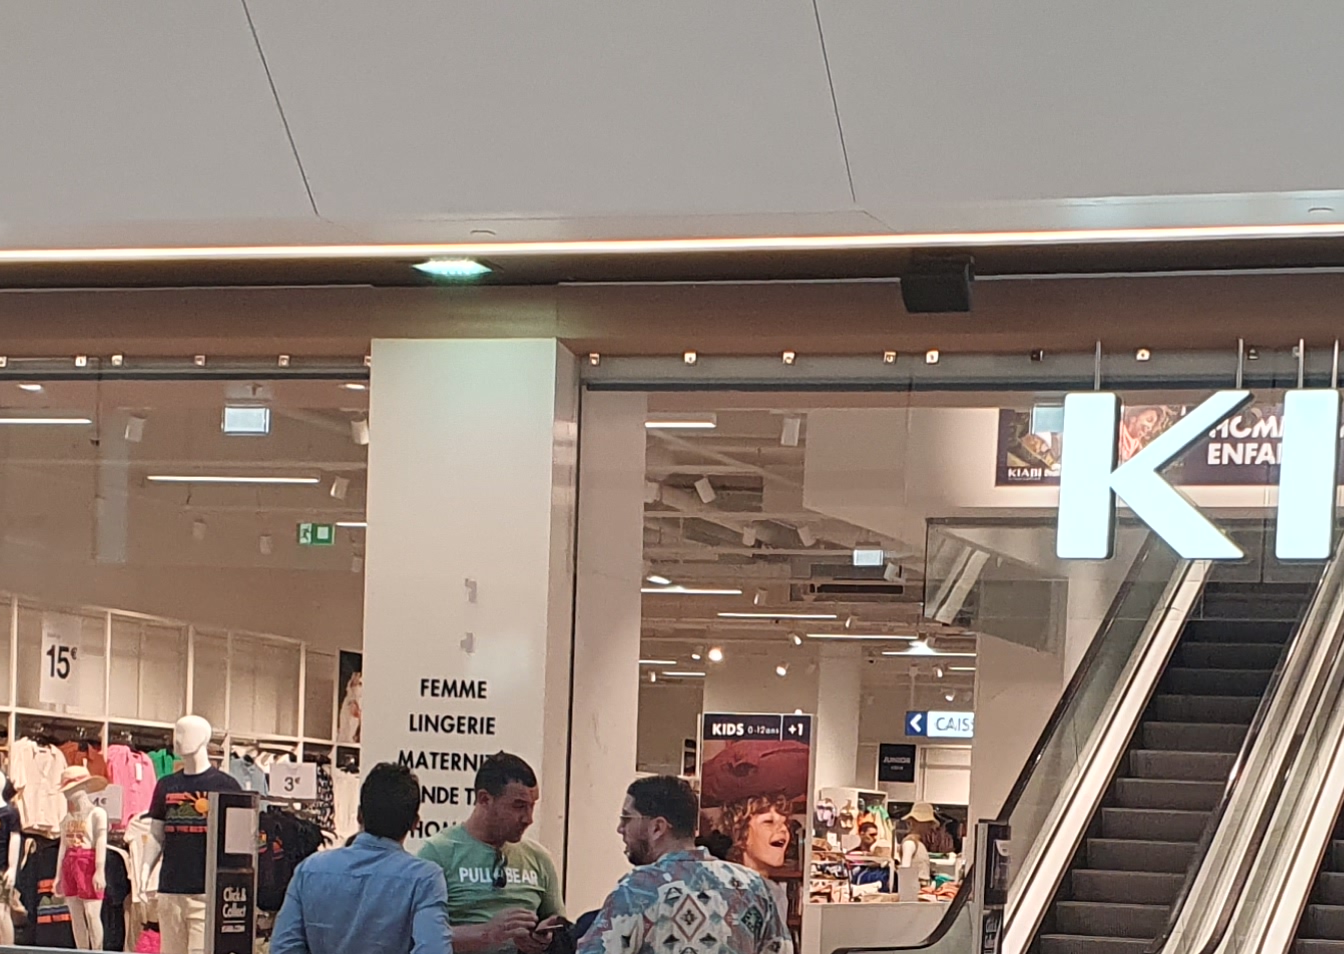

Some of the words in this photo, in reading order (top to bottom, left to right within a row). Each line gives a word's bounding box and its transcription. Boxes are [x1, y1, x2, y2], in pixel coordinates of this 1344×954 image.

[46, 644, 78, 679] 15€
[420, 678, 487, 699] FEMME
[409, 713, 496, 735] LINGERIE
[712, 723, 744, 736] KIDS
[787, 723, 804, 736] +1
[935, 717, 973, 732] CAIS
[398, 749, 492, 772] MATERNI
[421, 785, 459, 805] NDE
